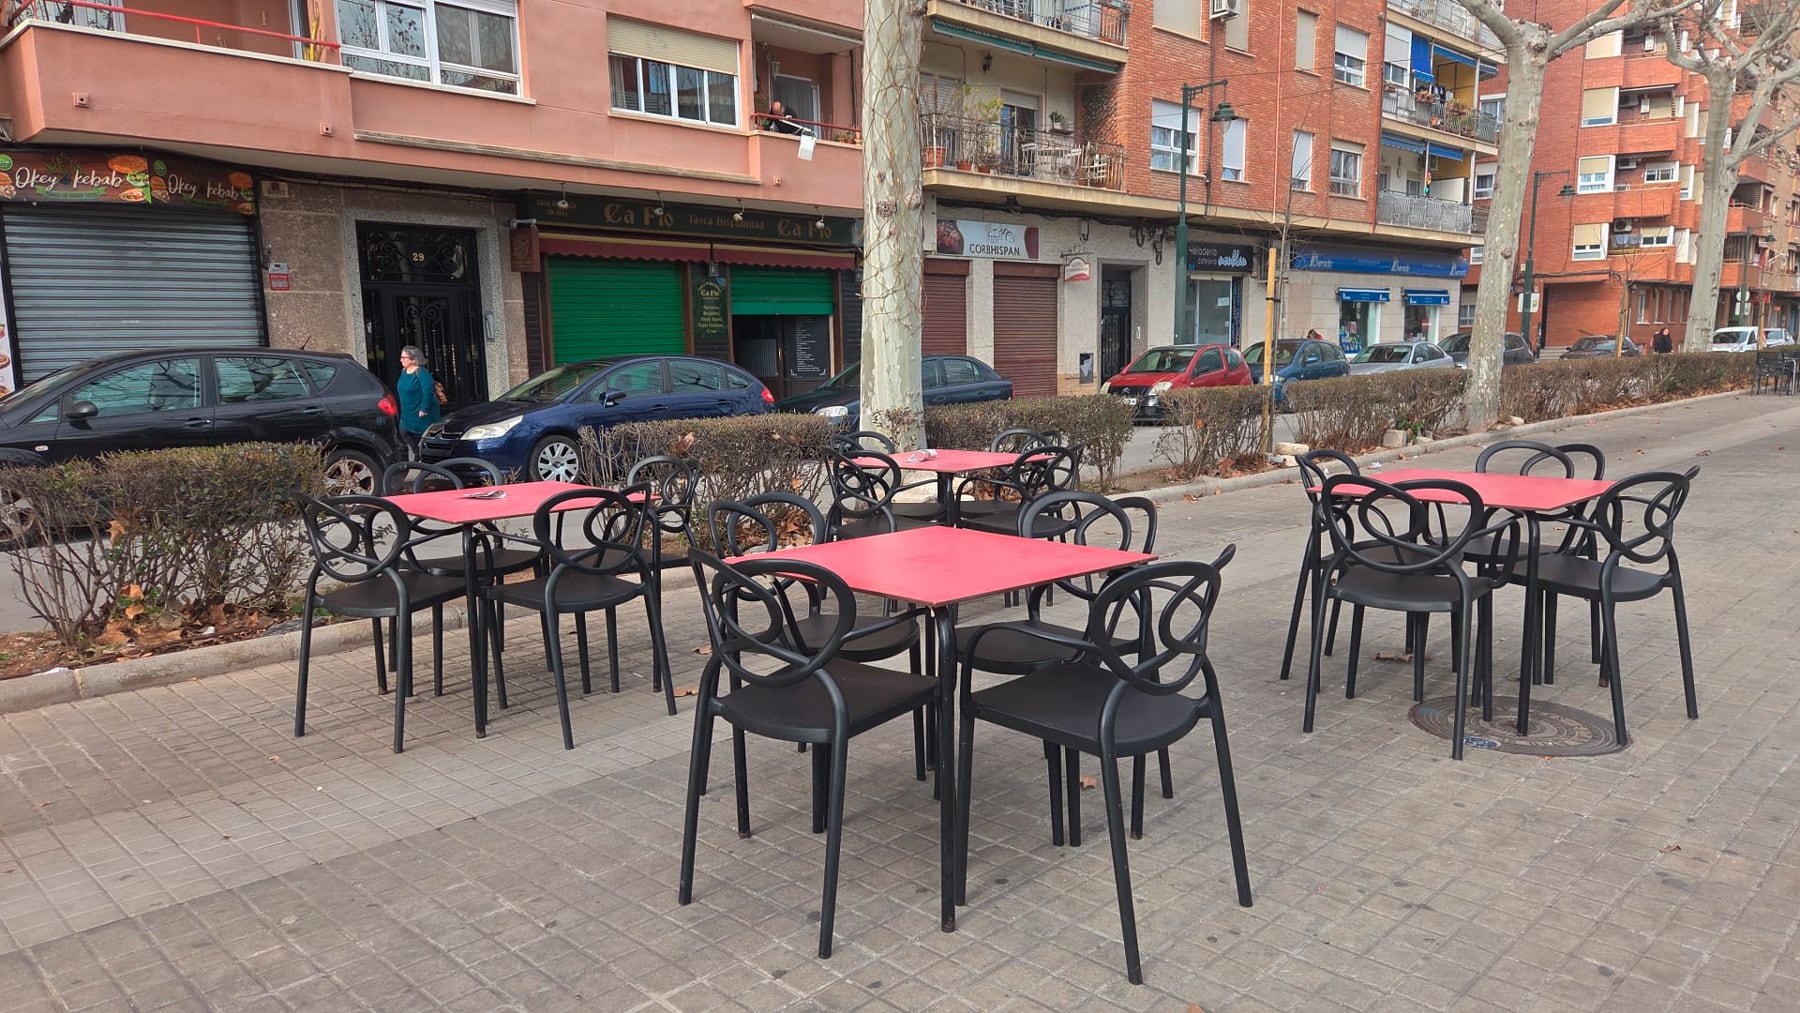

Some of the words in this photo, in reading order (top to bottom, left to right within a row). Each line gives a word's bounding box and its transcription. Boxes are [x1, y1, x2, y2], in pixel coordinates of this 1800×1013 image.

[15, 167, 58, 191] Okey
[72, 169, 125, 189] kebab
[167, 174, 198, 198] Okey
[206, 181, 240, 200] kebab
[604, 203, 635, 225] Ca
[776, 218, 801, 239] Ca
[412, 252, 425, 262] 29
[969, 243, 1020, 257] CORBHISPAN
